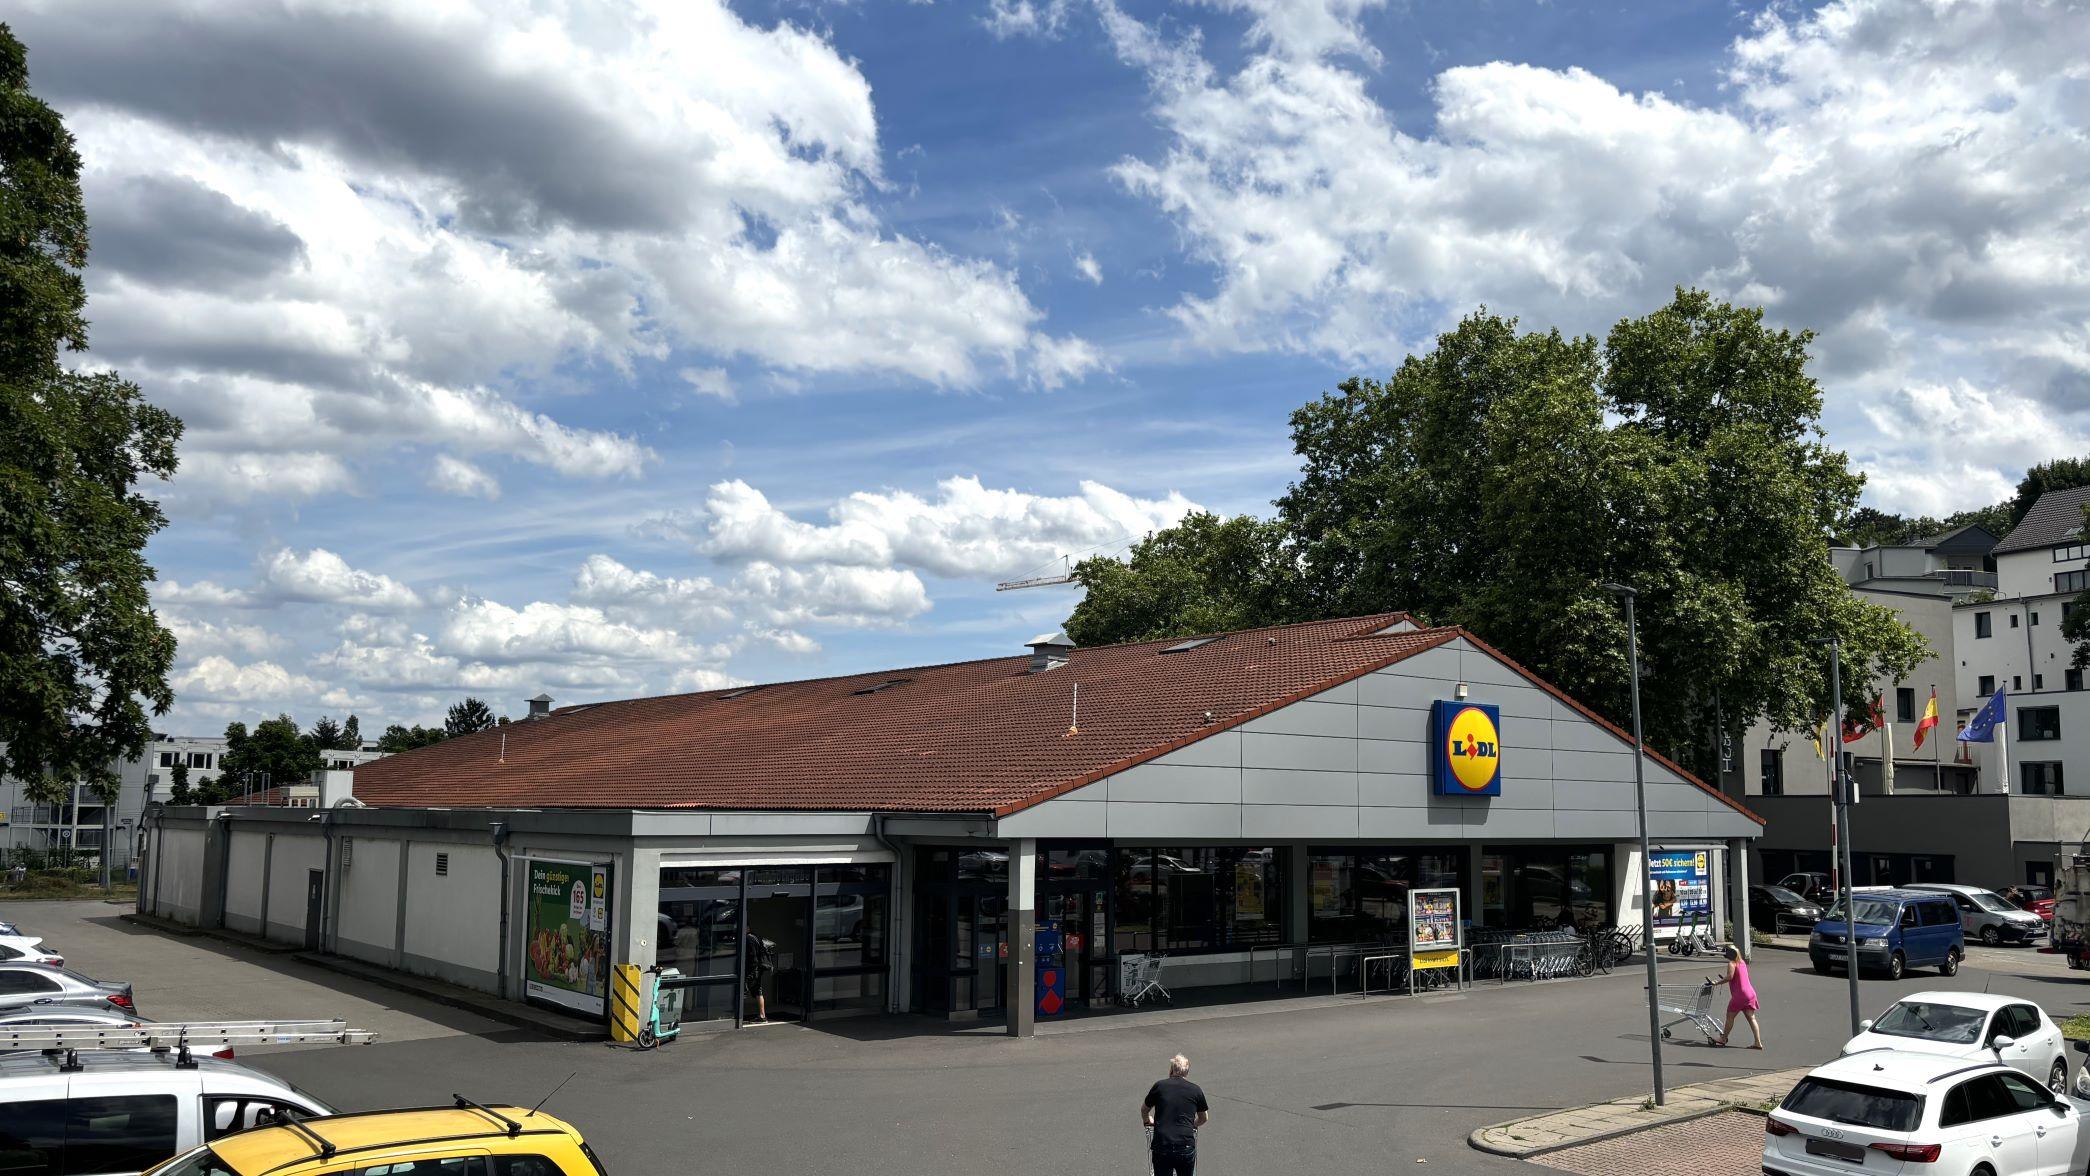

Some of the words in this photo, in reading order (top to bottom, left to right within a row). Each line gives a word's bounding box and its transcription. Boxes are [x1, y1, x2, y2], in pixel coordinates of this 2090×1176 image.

[1452, 733, 1497, 760] LIDL
[1662, 858, 1673, 868] 50€
[1674, 857, 1695, 867] sichern!
[534, 869, 545, 880] Dein
[545, 870, 570, 884] günstiger
[533, 883, 561, 896] Frischekick
[573, 890, 584, 904] 165
